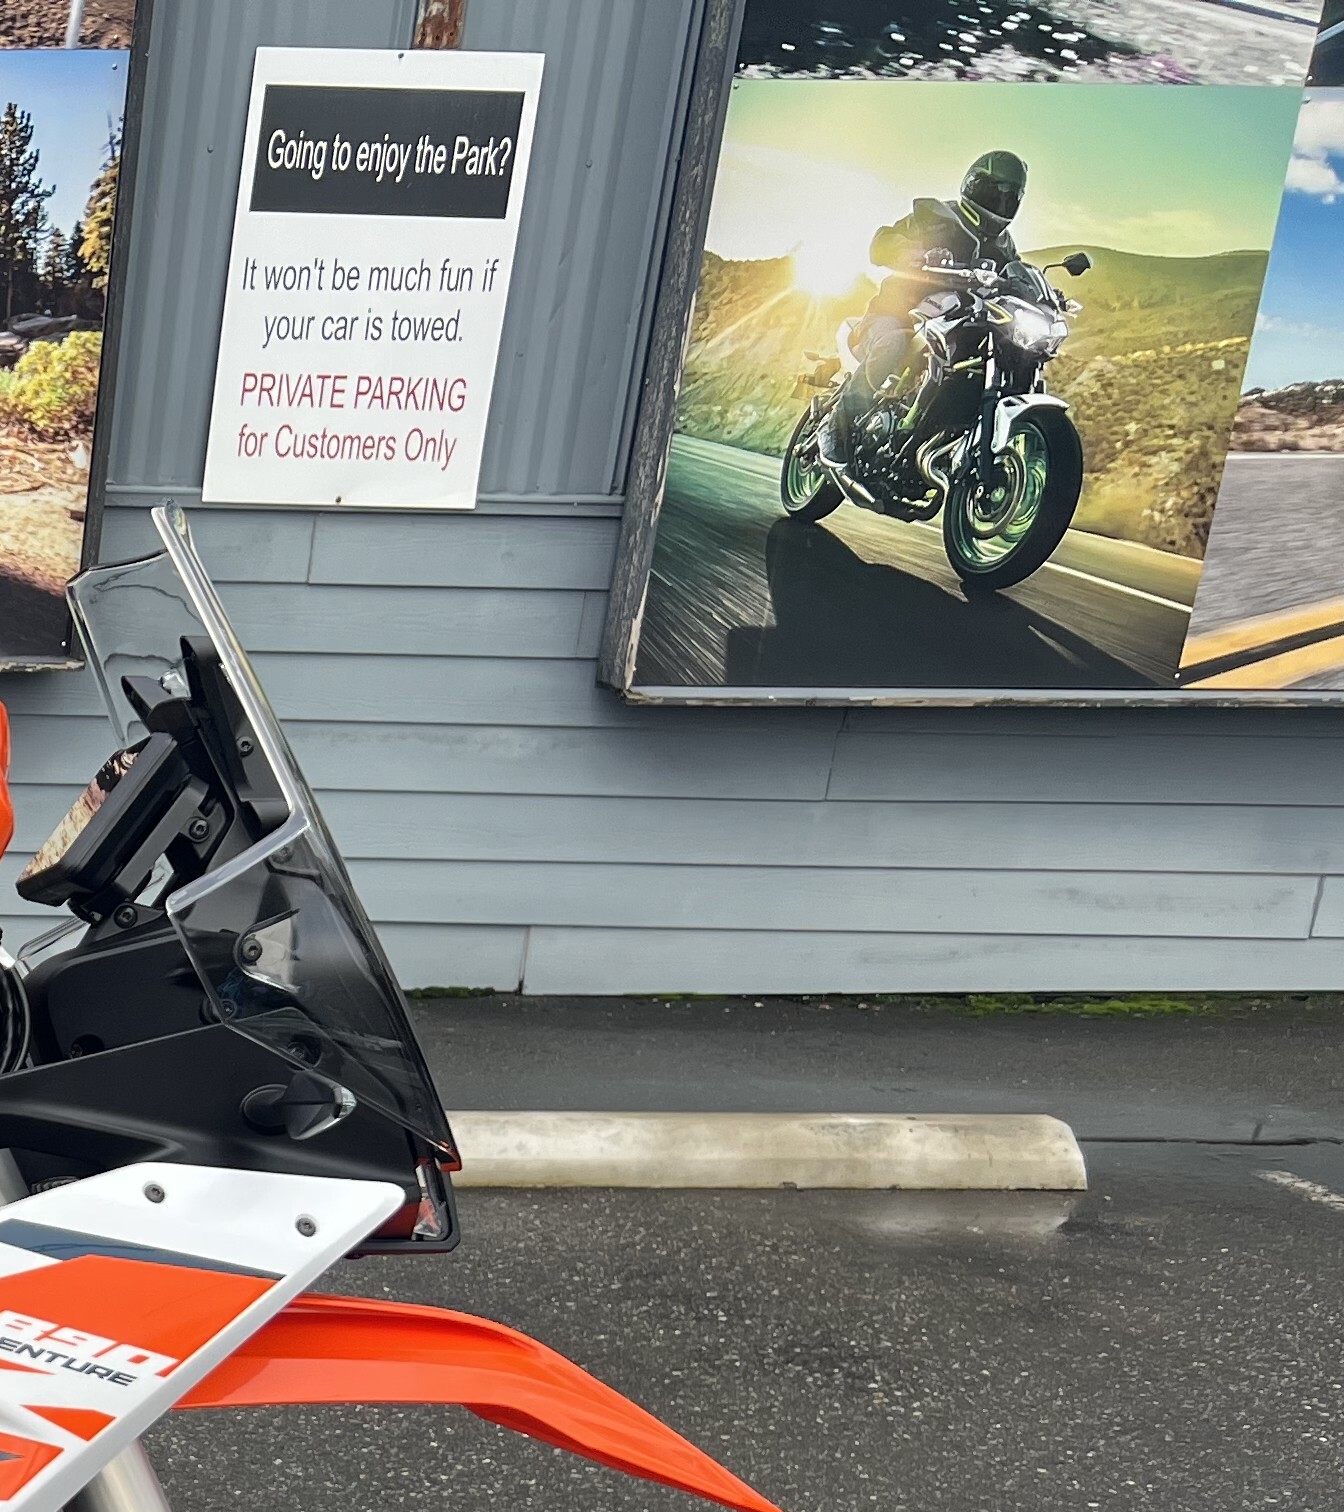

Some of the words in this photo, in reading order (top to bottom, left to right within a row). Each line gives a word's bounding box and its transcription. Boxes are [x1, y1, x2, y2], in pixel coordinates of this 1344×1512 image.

[267, 129, 326, 180] Going
[332, 134, 353, 171] to
[355, 134, 412, 183] enjoy
[415, 135, 446, 174] the
[450, 136, 512, 176] Park?
[242, 257, 257, 291] It
[263, 258, 325, 292] won't
[331, 258, 360, 292] be
[368, 258, 430, 292] much
[439, 258, 473, 293] fun
[481, 258, 498, 293] if
[262, 315, 315, 349] your
[320, 315, 357, 343] car
[364, 308, 383, 342] is
[390, 309, 463, 342] towed.
[239, 372, 347, 409] PRIVATE
[353, 376, 467, 413] PARKING
[237, 424, 269, 458] for
[274, 424, 396, 462] Customers
[404, 428, 457, 471] Only
